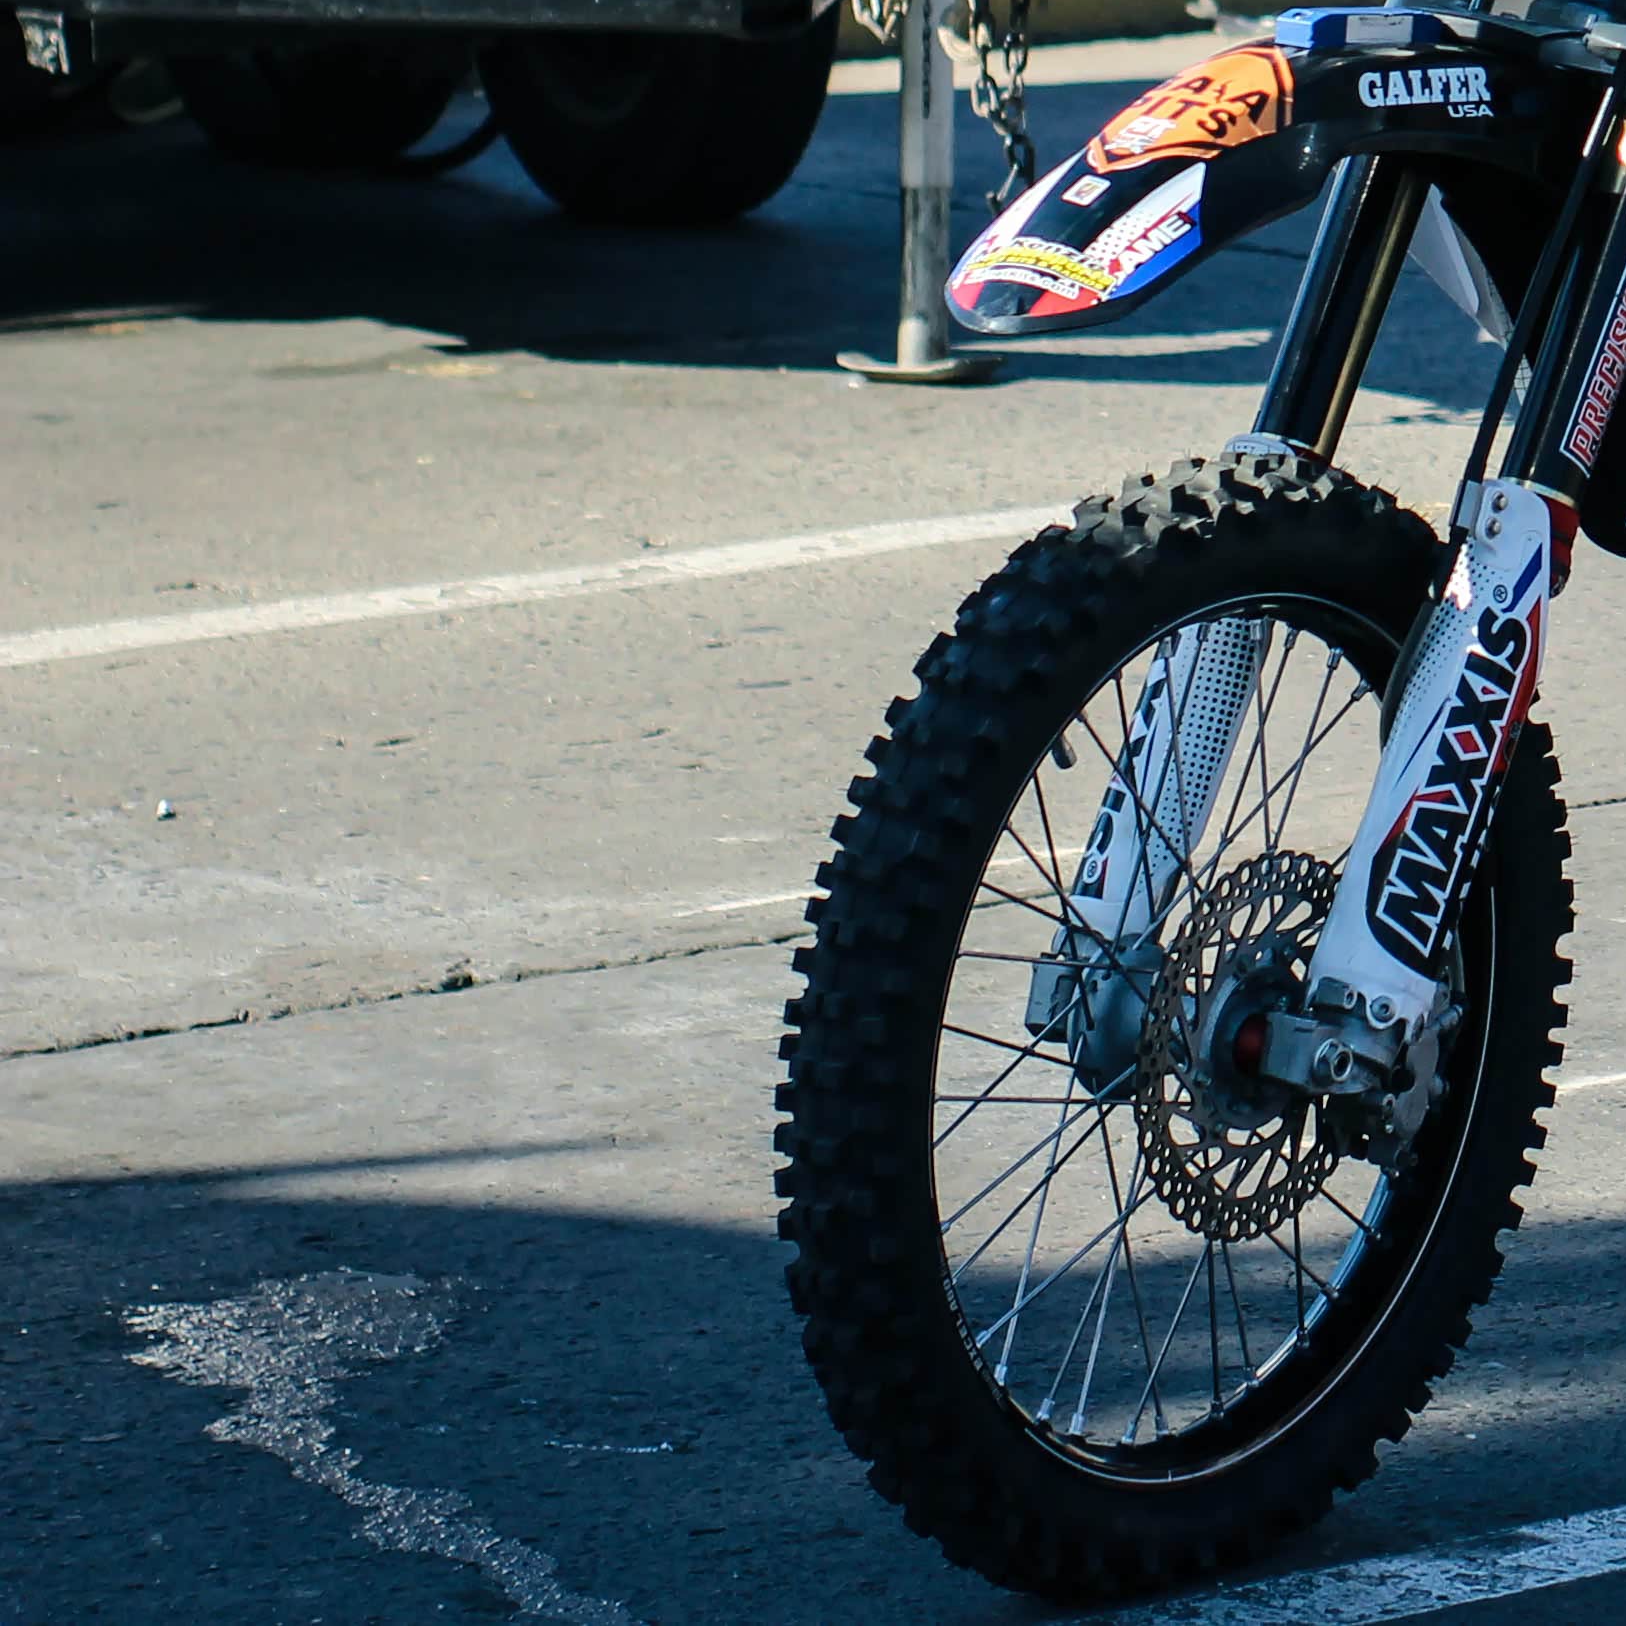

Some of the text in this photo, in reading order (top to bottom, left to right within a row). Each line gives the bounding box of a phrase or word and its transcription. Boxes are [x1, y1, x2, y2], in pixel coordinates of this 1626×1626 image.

[1358, 66, 1492, 108] GALFER
[1447, 103, 1494, 118] USA
[1376, 605, 1528, 958] MAXXIS
